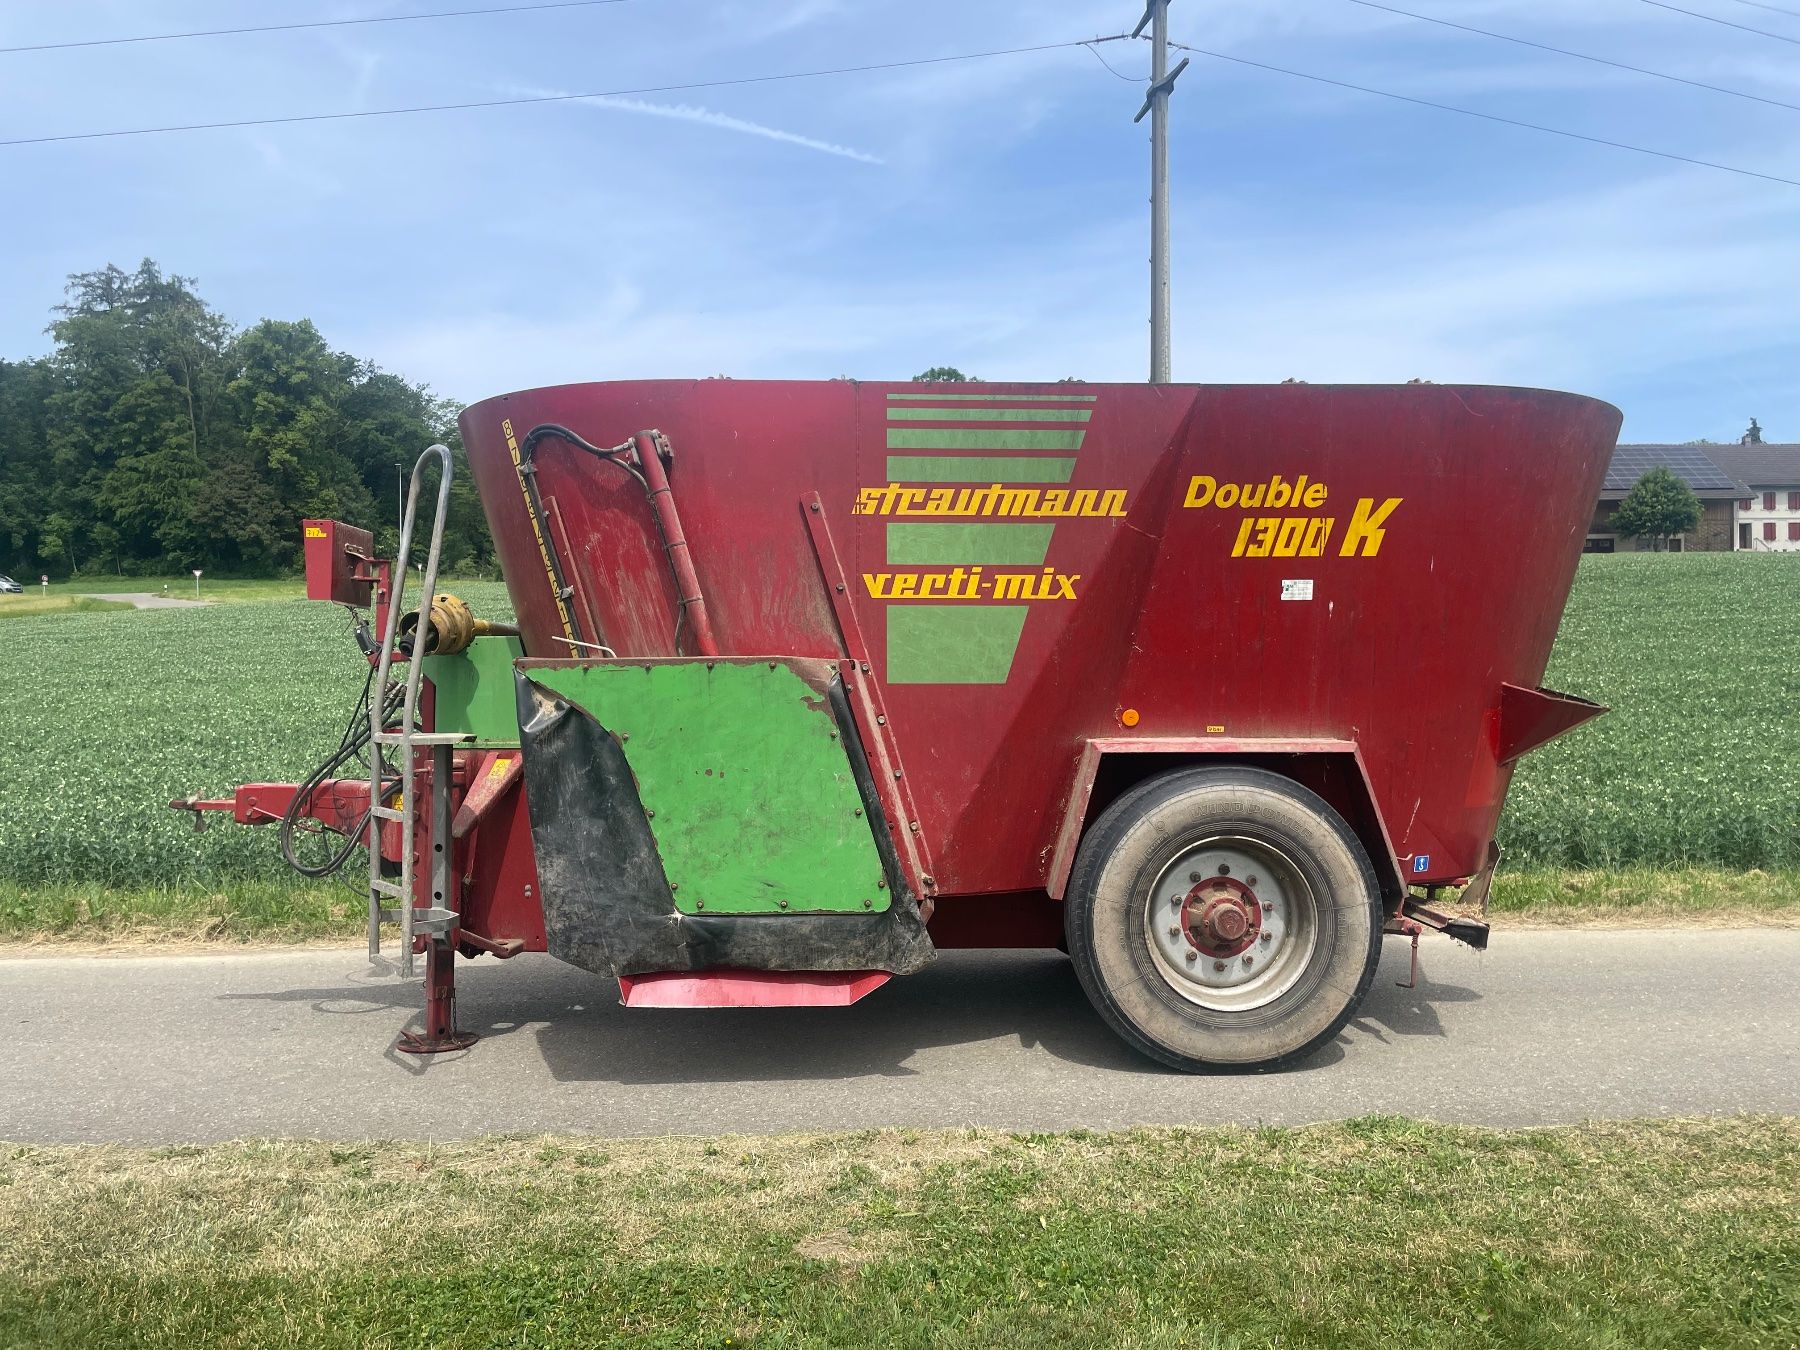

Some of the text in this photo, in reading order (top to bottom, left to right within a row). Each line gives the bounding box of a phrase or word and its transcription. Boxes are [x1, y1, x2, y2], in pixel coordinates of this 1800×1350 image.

[504, 422, 511, 436] 8
[851, 483, 1128, 517] strautmann
[1183, 475, 1328, 508] Double
[1231, 518, 1335, 557] 1300
[1339, 498, 1404, 557] K
[862, 567, 1081, 600] verti-mix
